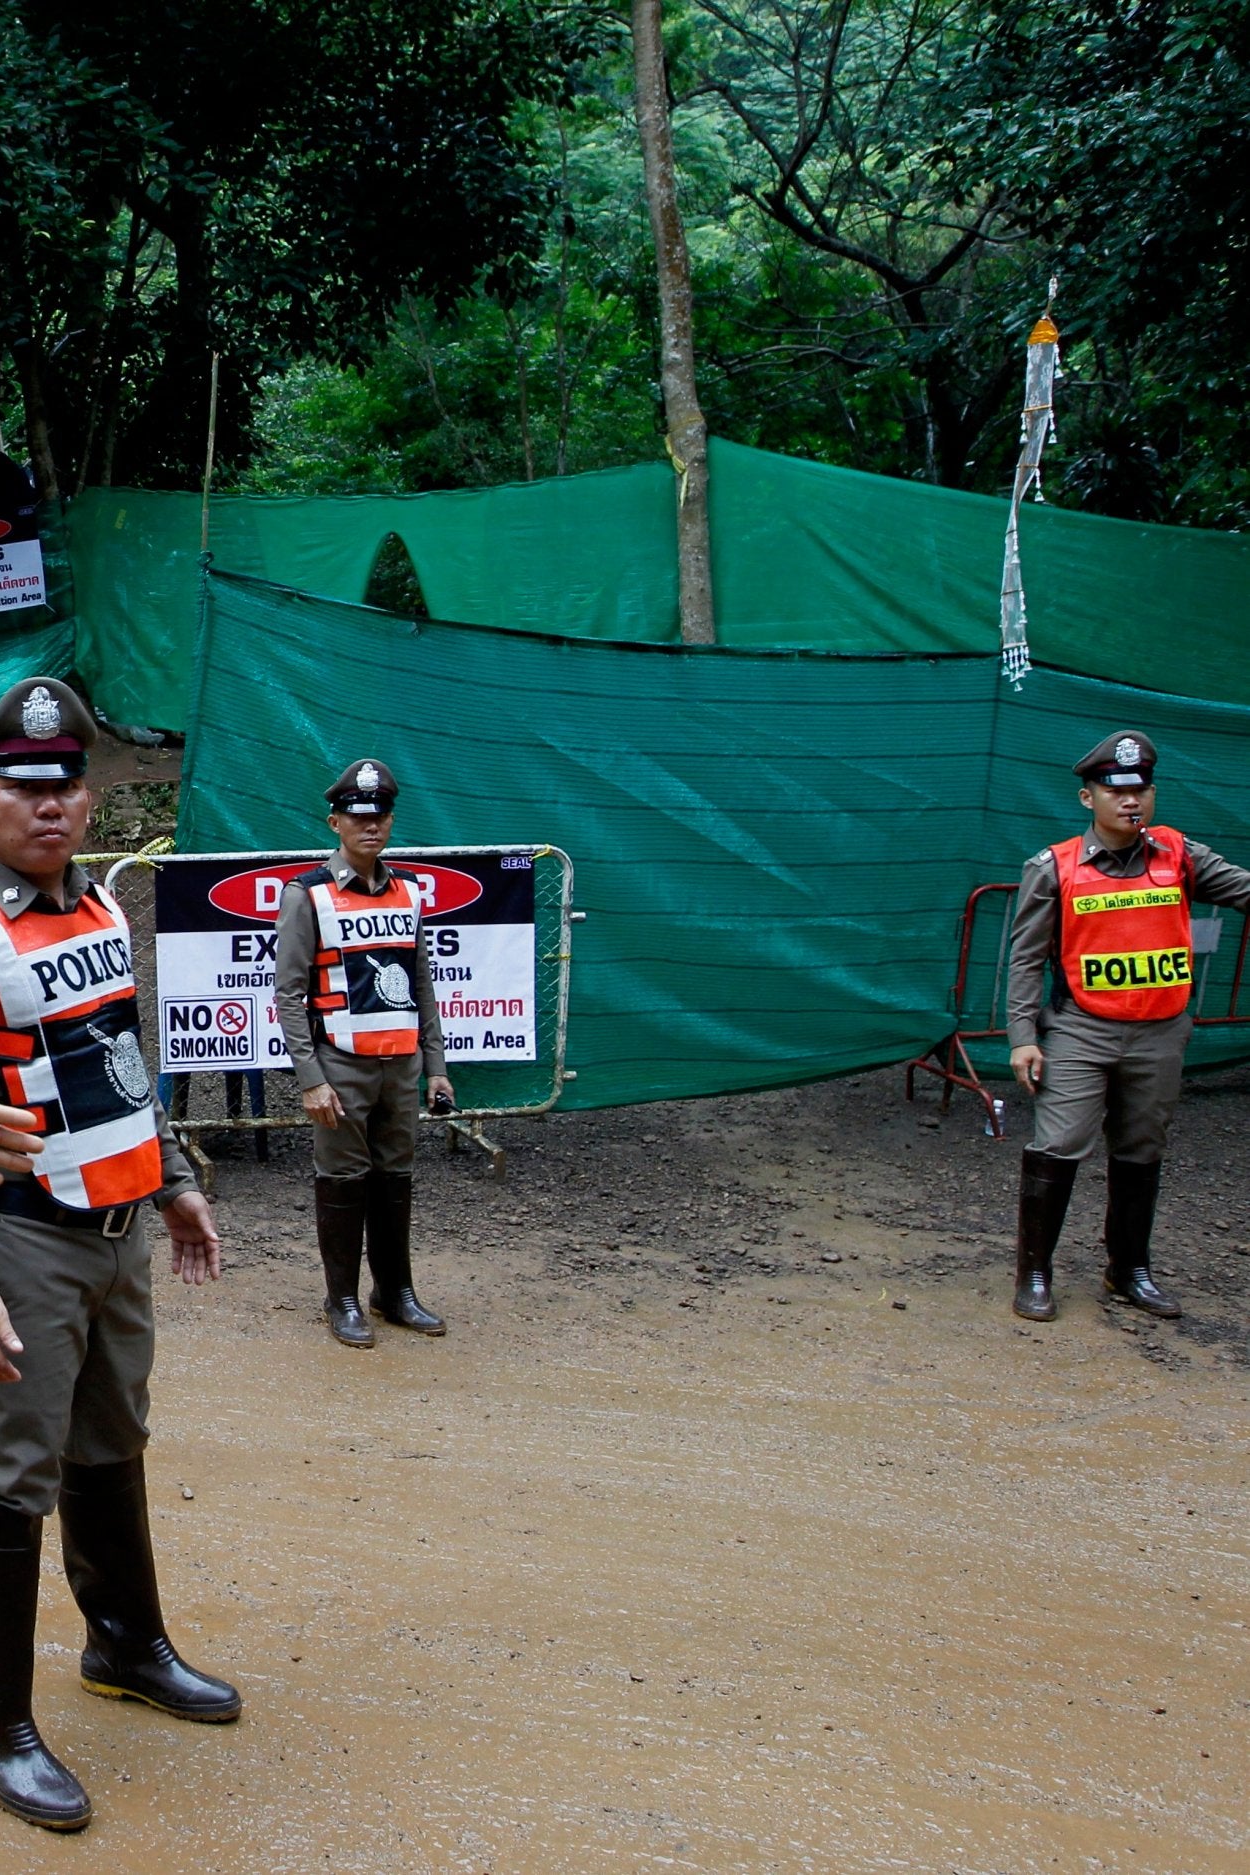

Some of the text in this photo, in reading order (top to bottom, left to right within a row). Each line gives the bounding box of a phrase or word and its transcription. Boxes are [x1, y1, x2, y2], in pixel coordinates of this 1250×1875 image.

[21, 592, 42, 602] Area
[501, 856, 532, 869] SEAL
[338, 914, 416, 941] POLICE
[1084, 951, 1190, 987] POLICE
[169, 1004, 212, 1032] NO
[170, 1035, 249, 1059] SMOKING
[482, 1031, 525, 1049] Area
